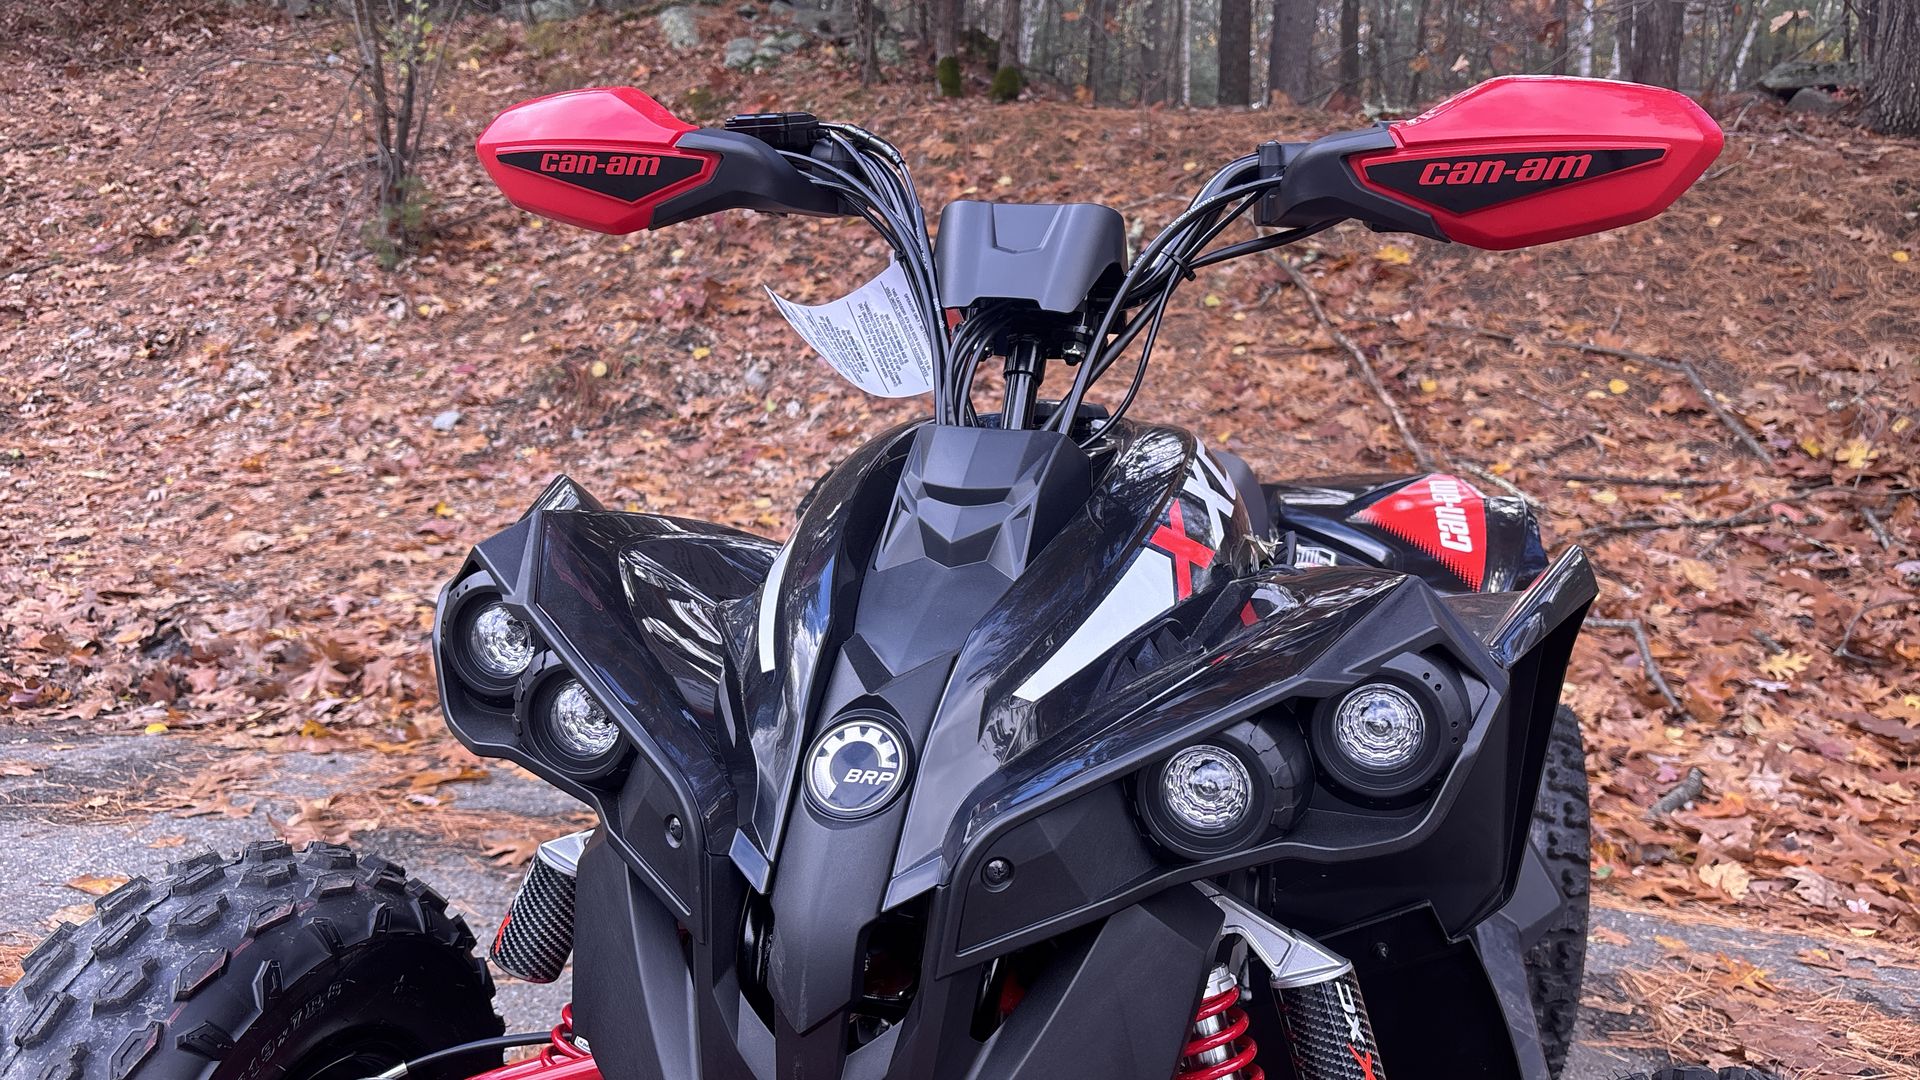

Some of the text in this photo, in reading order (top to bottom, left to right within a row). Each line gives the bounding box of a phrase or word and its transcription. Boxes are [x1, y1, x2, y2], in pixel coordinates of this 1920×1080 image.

[539, 152, 661, 177] can-am
[1418, 154, 1592, 186] can-am
[1428, 480, 1473, 553] can-am
[843, 768, 895, 786] BRP
